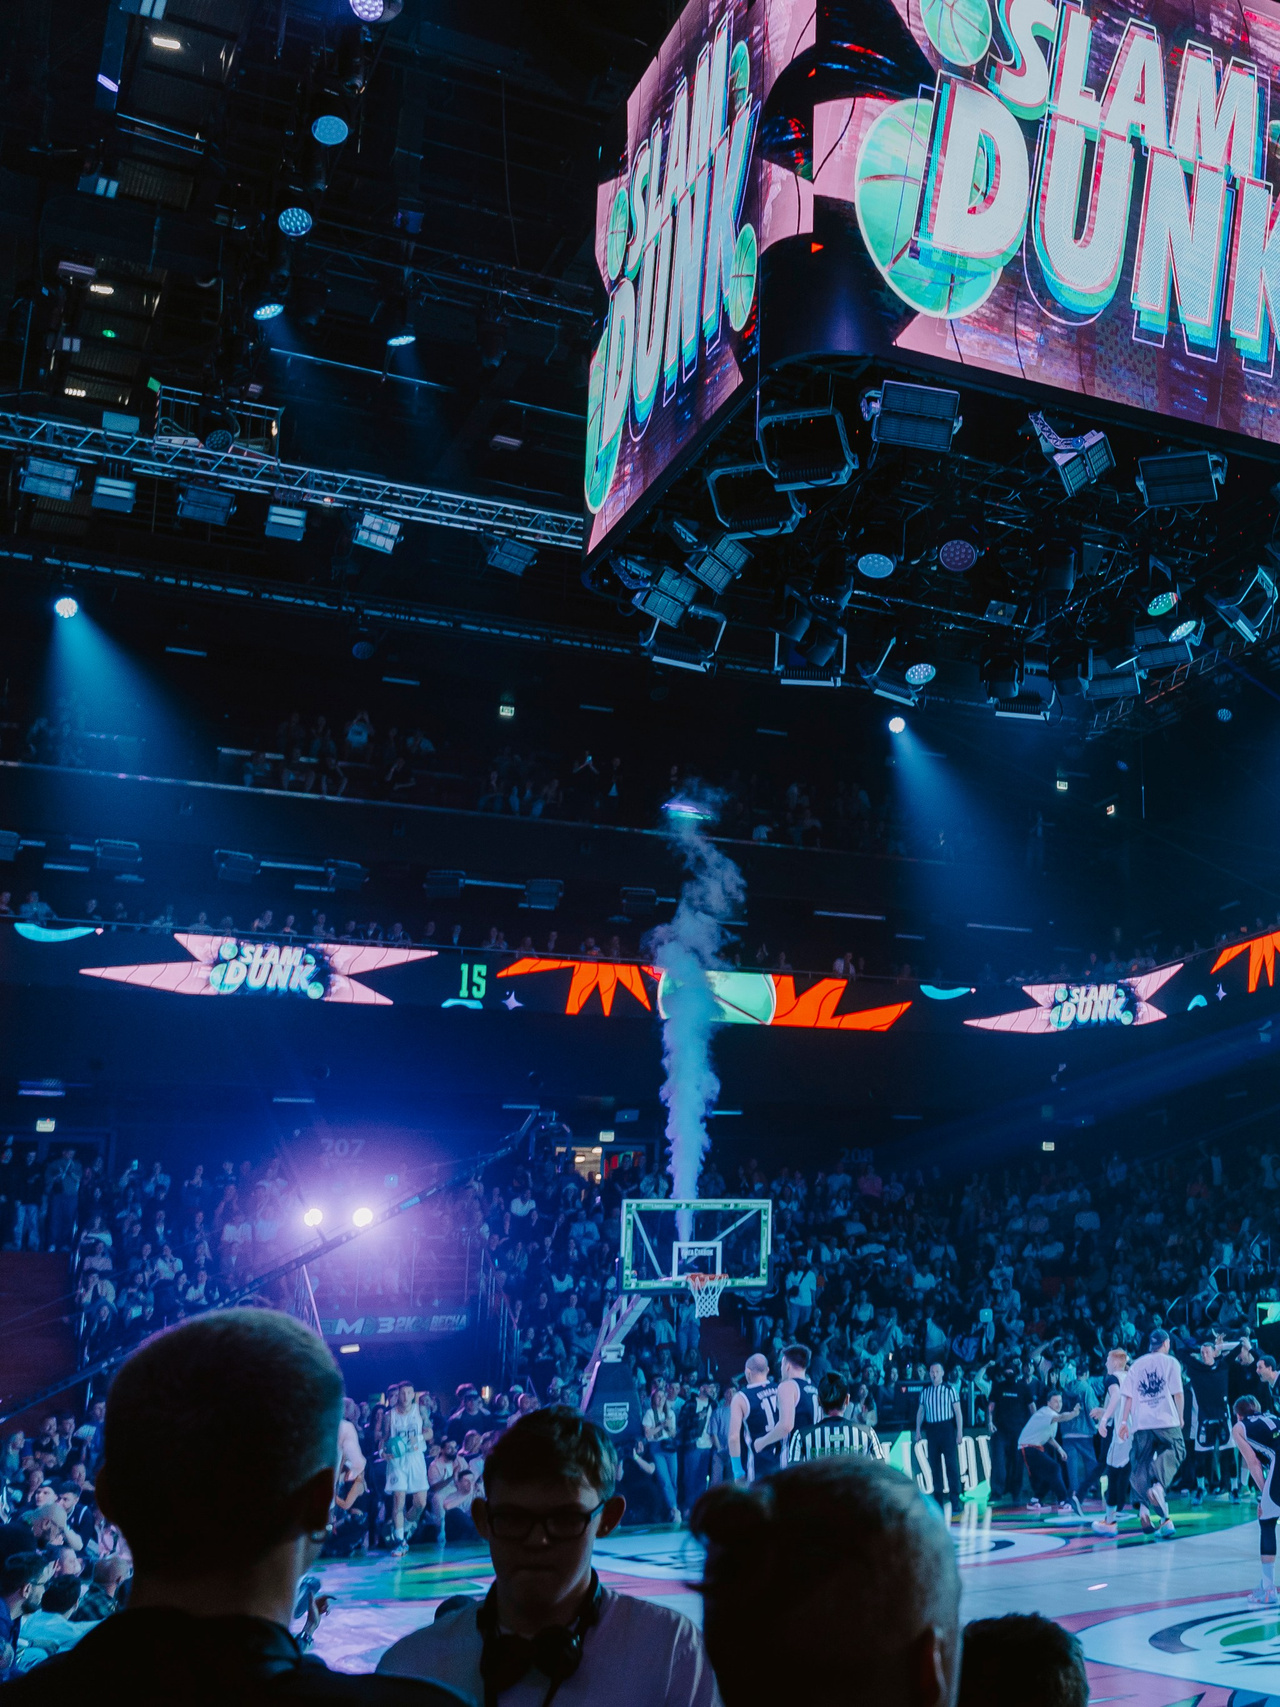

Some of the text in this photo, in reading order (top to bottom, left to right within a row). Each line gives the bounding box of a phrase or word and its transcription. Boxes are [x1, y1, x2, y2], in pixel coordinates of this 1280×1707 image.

[990, 0, 1262, 178] SLAM
[627, 20, 730, 278] SLAM
[602, 97, 753, 450] DUNK
[240, 945, 305, 966] SLAM
[224, 960, 317, 990] DUNK
[459, 963, 487, 998] 15
[1060, 997, 1126, 1023] DUNK
[1069, 984, 1117, 1004] SLAM
